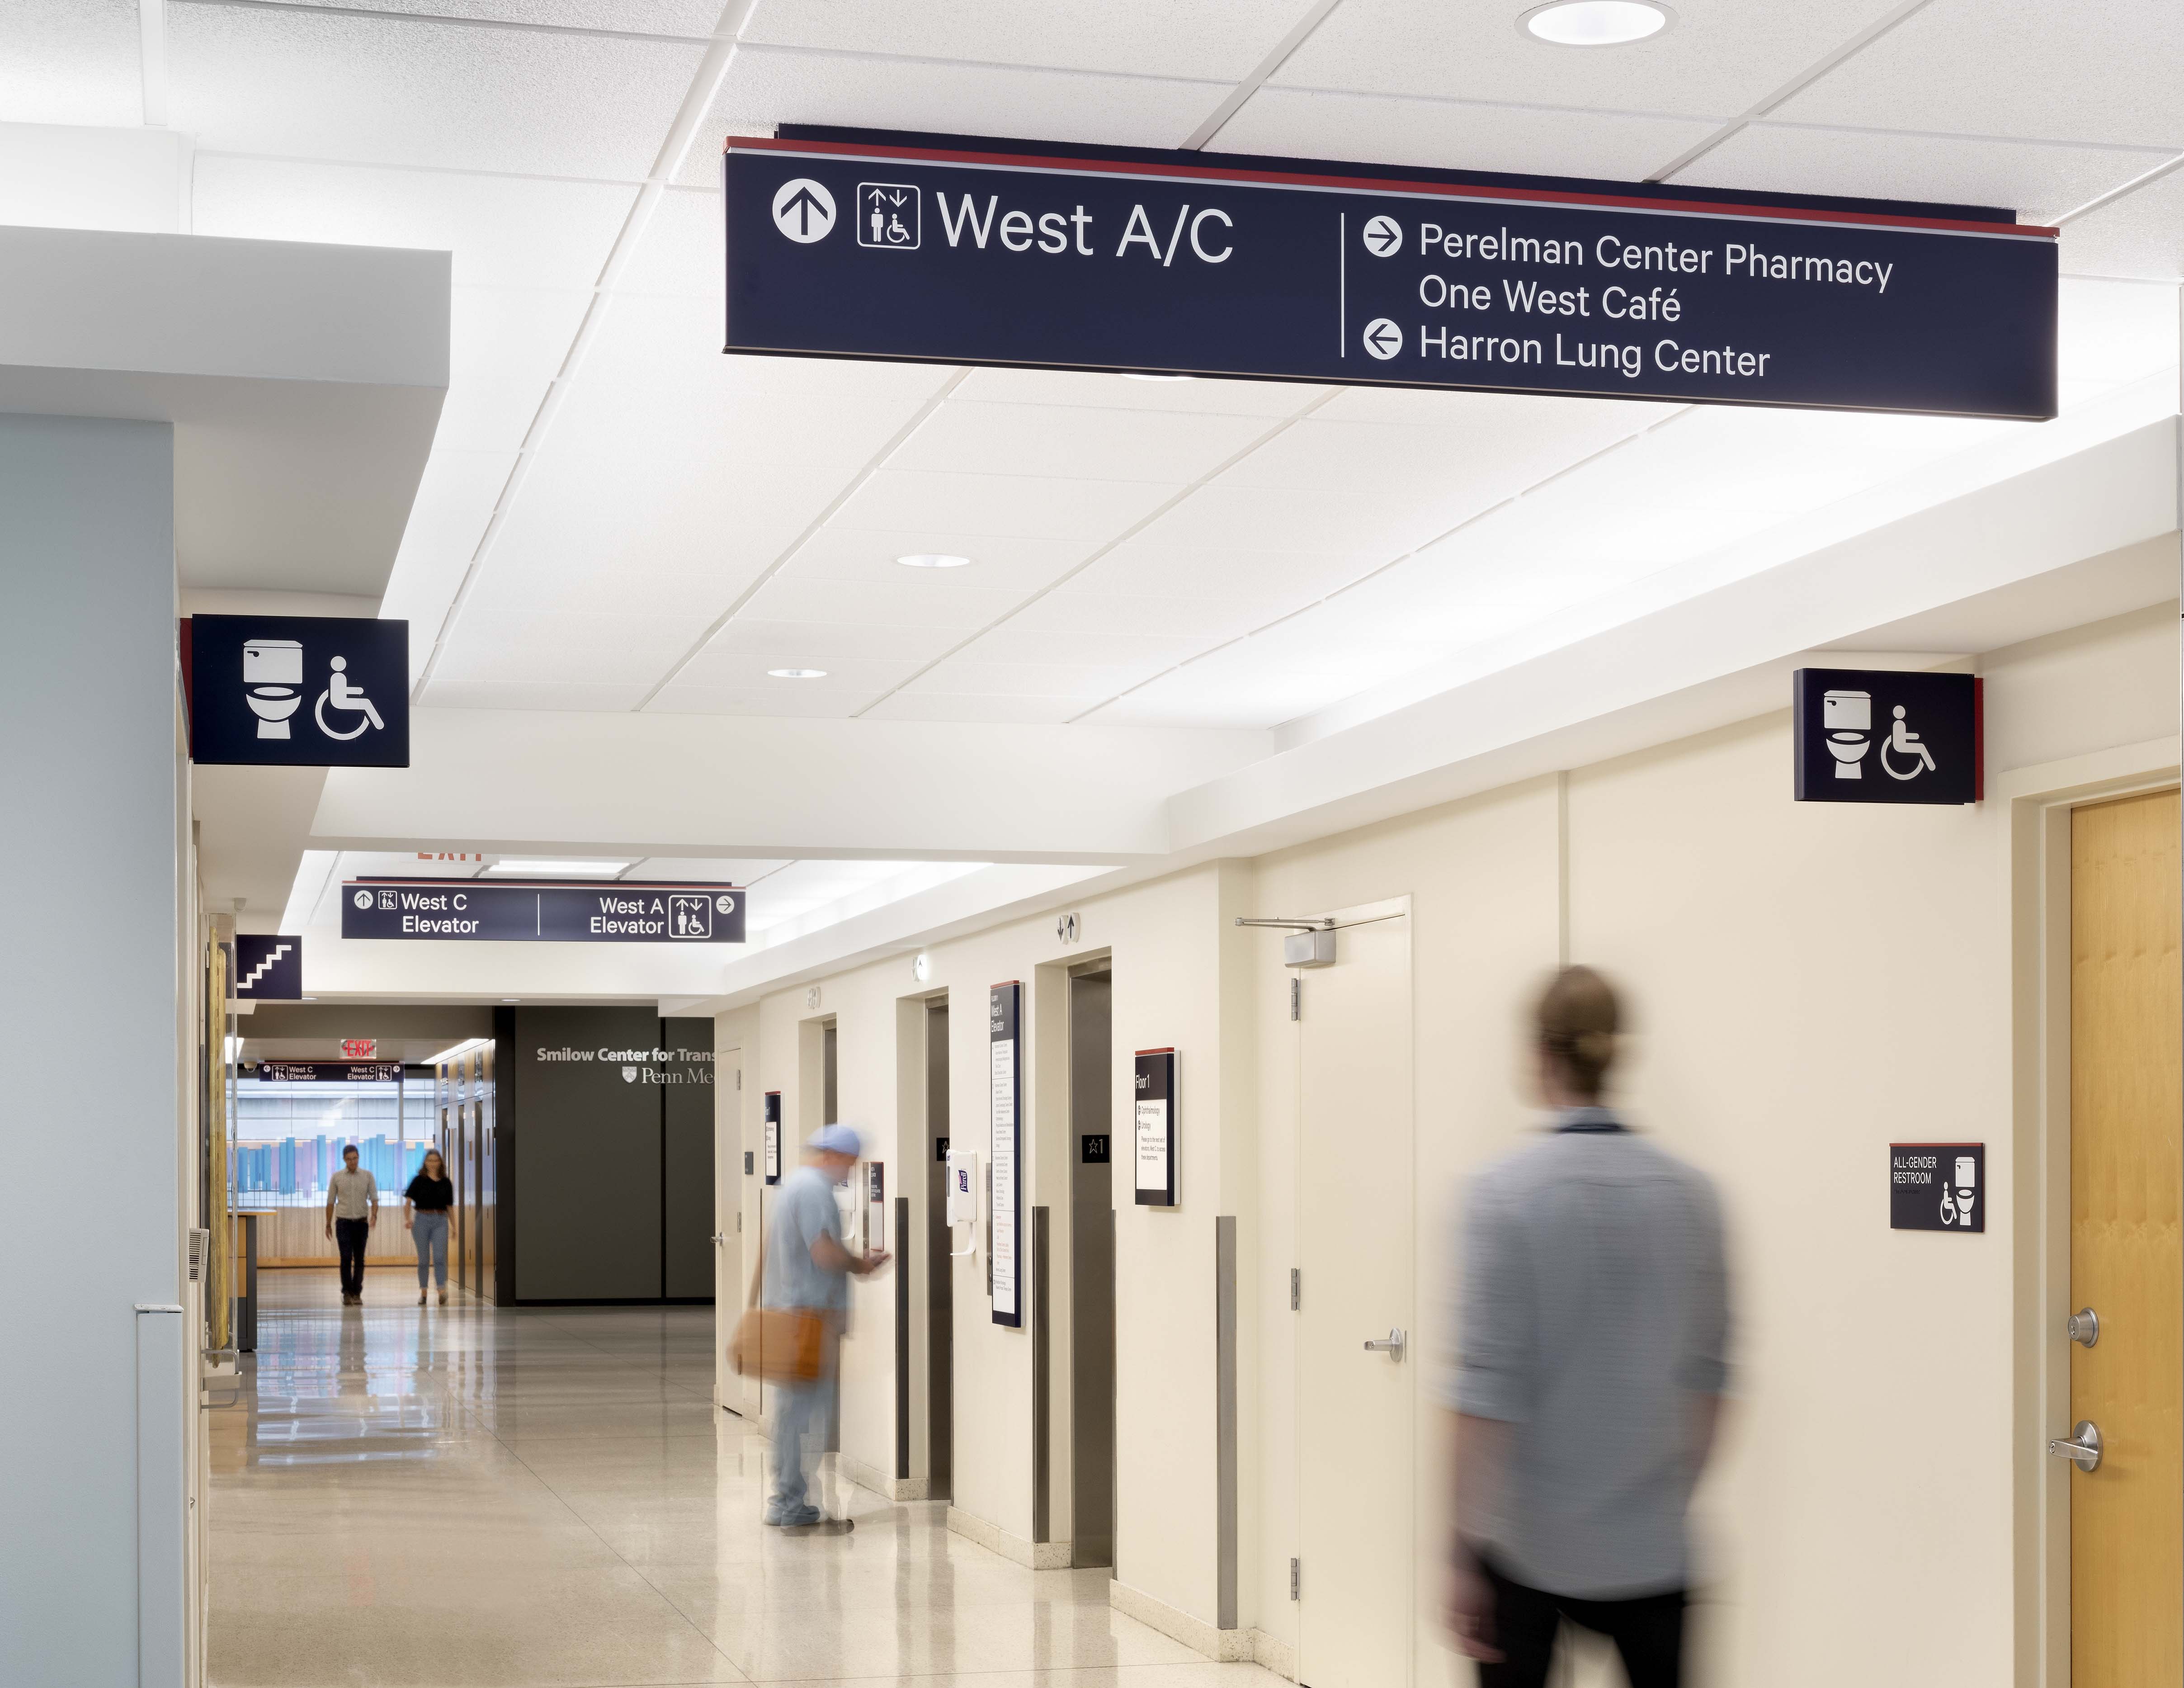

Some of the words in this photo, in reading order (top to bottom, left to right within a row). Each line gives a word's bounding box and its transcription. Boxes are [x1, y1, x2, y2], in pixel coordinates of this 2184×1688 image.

[936, 192, 1093, 255] West
[1116, 204, 1233, 267] A/C
[1421, 223, 1583, 266] Perelman
[1596, 235, 1713, 273] Center
[1726, 244, 1894, 293] Pharmacy
[1419, 274, 1491, 310] One
[1502, 279, 1590, 317] West
[1602, 286, 1681, 322] Café
[1421, 325, 1542, 364] Harron
[1556, 333, 1642, 378] Lung
[1654, 339, 1771, 377] Center
[401, 893, 448, 910] West
[453, 894, 467, 911] C
[599, 897, 646, 914] West
[650, 898, 665, 914] A
[402, 915, 479, 933] Elevator
[590, 916, 665, 934] Elevator
[991, 1005, 999, 1017] West
[999, 1003, 1002, 1016] A
[991, 1020, 1004, 1032] Elevator
[347, 1040, 371, 1057] EXIT
[537, 1047, 595, 1061] Smilow
[598, 1048, 650, 1062] Center
[651, 1047, 675, 1062] for
[641, 1067, 683, 1084] Penn
[686, 1068, 715, 1084] Me
[1136, 1074, 1147, 1089] Floor
[1147, 1074, 1150, 1088] 1
[1141, 1106, 1160, 1116] Ophthalmology
[1141, 1121, 1151, 1131] Urology
[1099, 1139, 1103, 1154] 1
[1893, 1156, 1937, 1168] ALL-GENDER
[1893, 1172, 1932, 1184] RESTROOM
